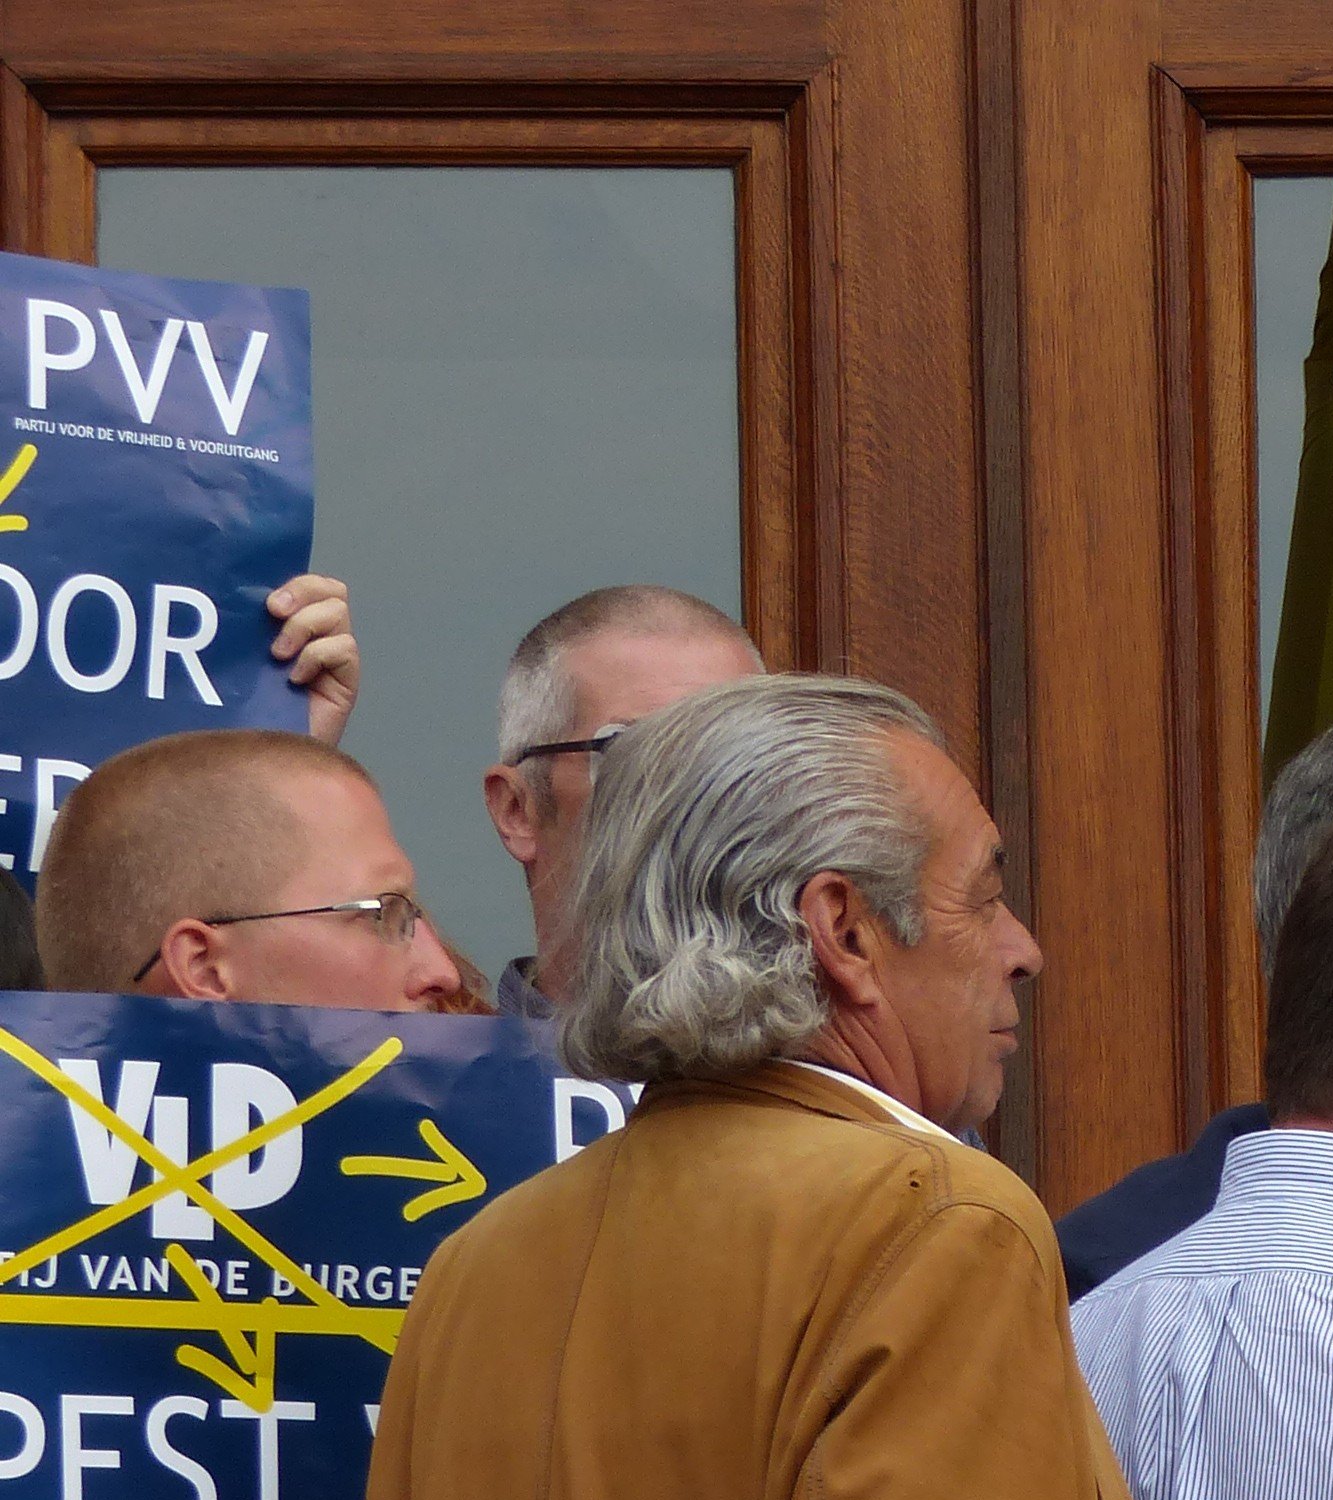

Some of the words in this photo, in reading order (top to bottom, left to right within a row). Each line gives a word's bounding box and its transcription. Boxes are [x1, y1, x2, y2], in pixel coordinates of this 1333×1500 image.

[27, 298, 269, 435] PVV
[14, 417, 56, 433] PARTIJ
[58, 423, 95, 439] VOOR
[98, 427, 114, 441] DE
[117, 430, 173, 449] VRIJHEID
[177, 438, 187, 450] &
[189, 439, 280, 463] VOORUITGANG
[58, 1058, 303, 1240] VLD
[79, 1254, 170, 1293] VAN
[196, 1259, 250, 1295] DE
